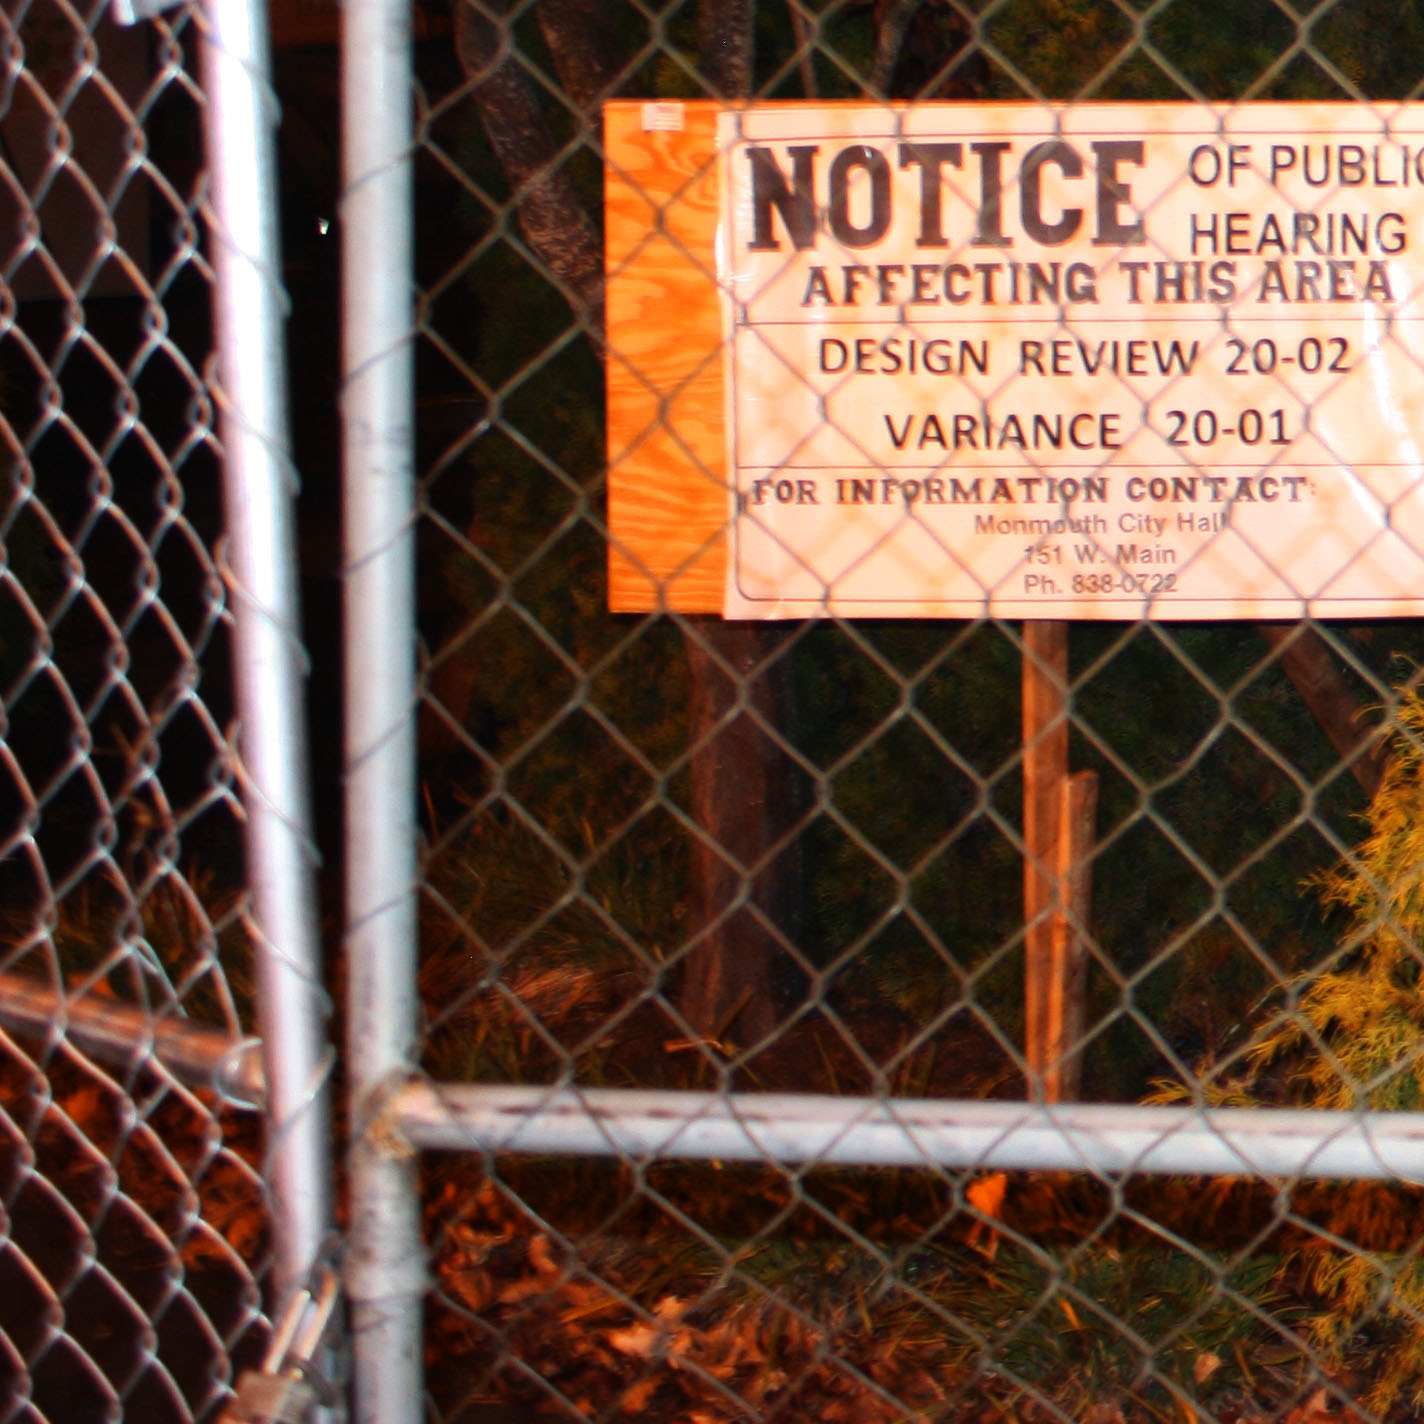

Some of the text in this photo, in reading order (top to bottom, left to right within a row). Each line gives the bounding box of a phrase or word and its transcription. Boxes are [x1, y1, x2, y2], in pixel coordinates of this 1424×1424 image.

[1189, 145, 1251, 186] OF
[746, 141, 1146, 250] NOTICE
[1190, 212, 1407, 254] HEARING
[801, 260, 1393, 306] AFFECTING THIS AREA
[820, 337, 1352, 376] DESIGN REVIEW 20-02
[884, 409, 1292, 450] VARIANCE 20-01
[752, 476, 1317, 505] FOR INFORMATION CONTACT:
[975, 512, 1225, 536] Monmouth City Hall
[1025, 544, 1176, 564] 151 W. Main
[1024, 574, 1062, 594] Ph.
